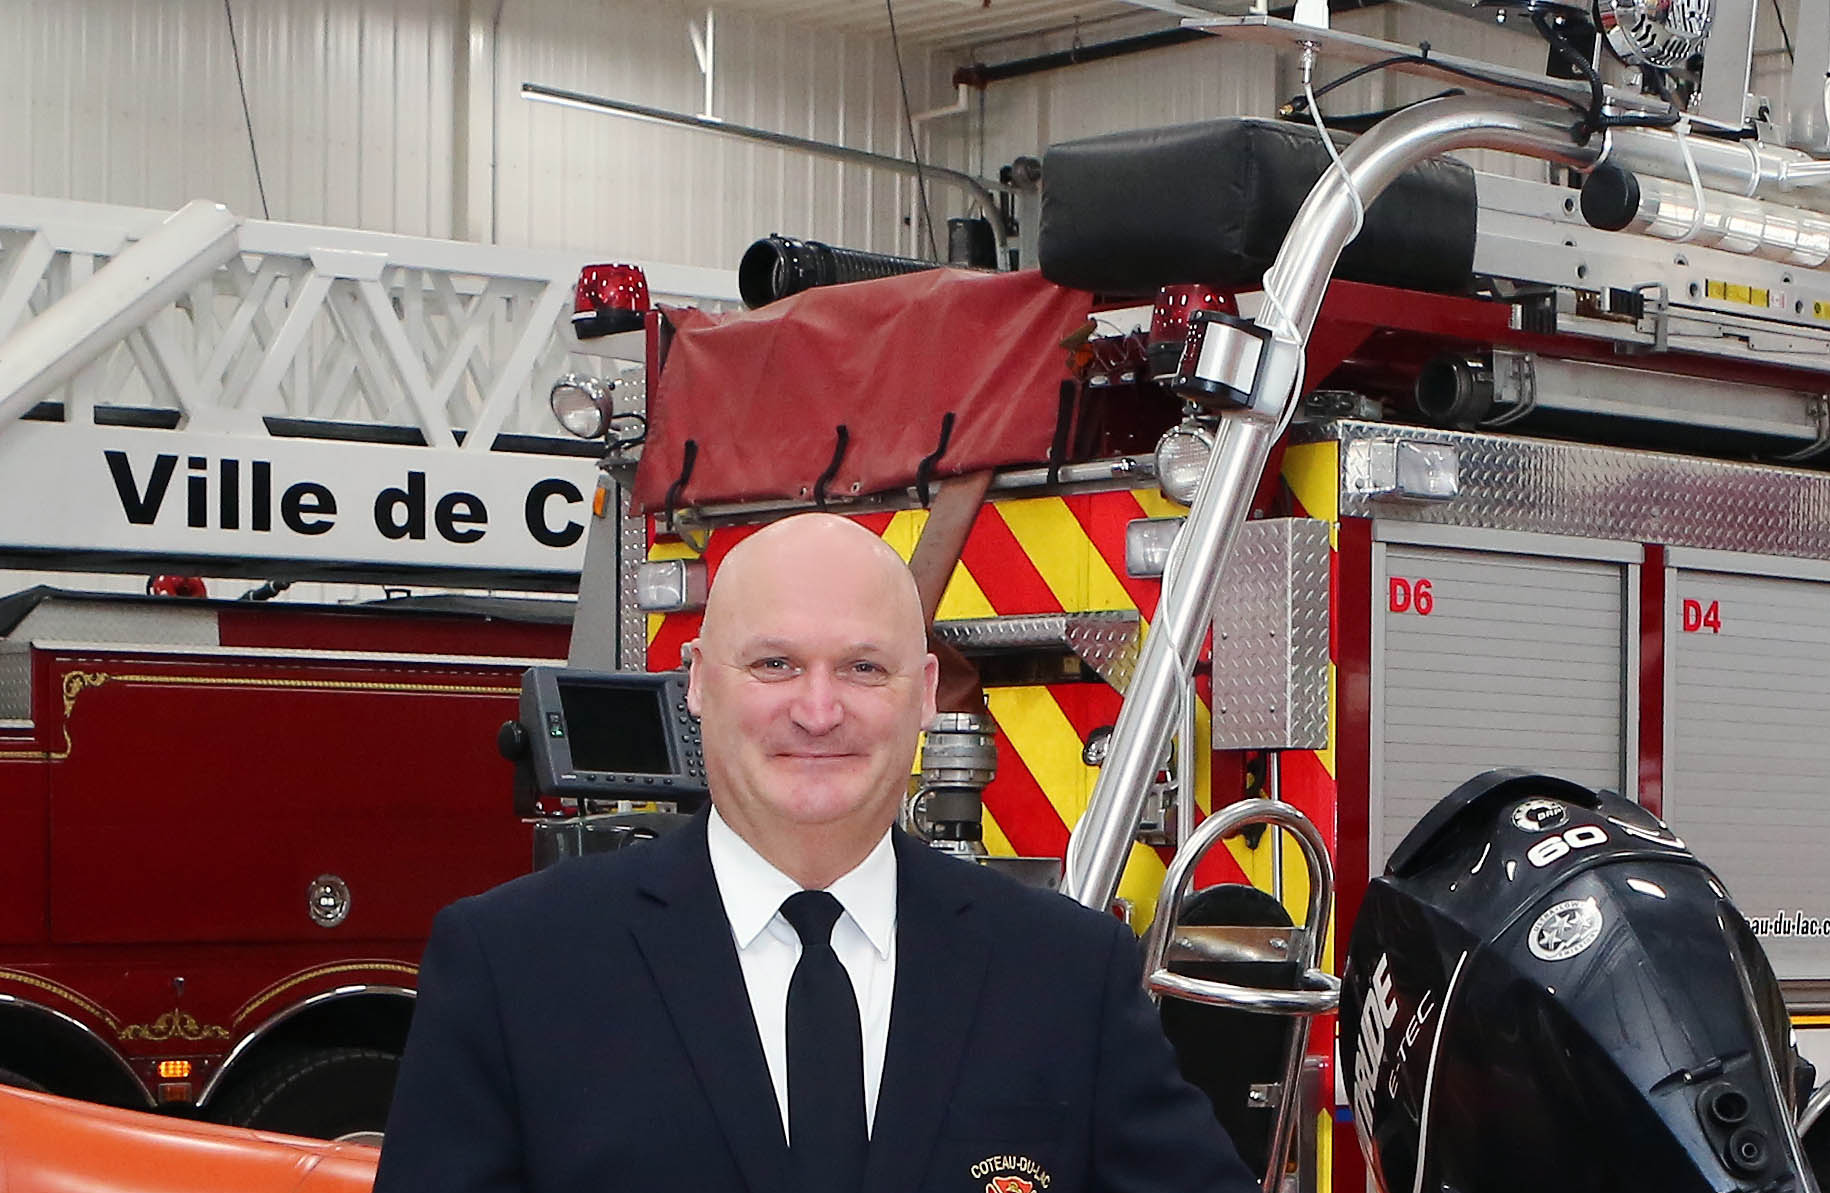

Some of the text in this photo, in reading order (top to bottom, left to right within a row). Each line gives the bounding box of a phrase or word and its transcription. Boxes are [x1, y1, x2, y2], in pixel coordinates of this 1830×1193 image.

[104, 450, 585, 547] Ville de C
[1389, 576, 1433, 616] D6
[1683, 598, 1721, 634] D4
[1527, 825, 1608, 867] 60
[1388, 989, 1435, 1099] E-TEC
